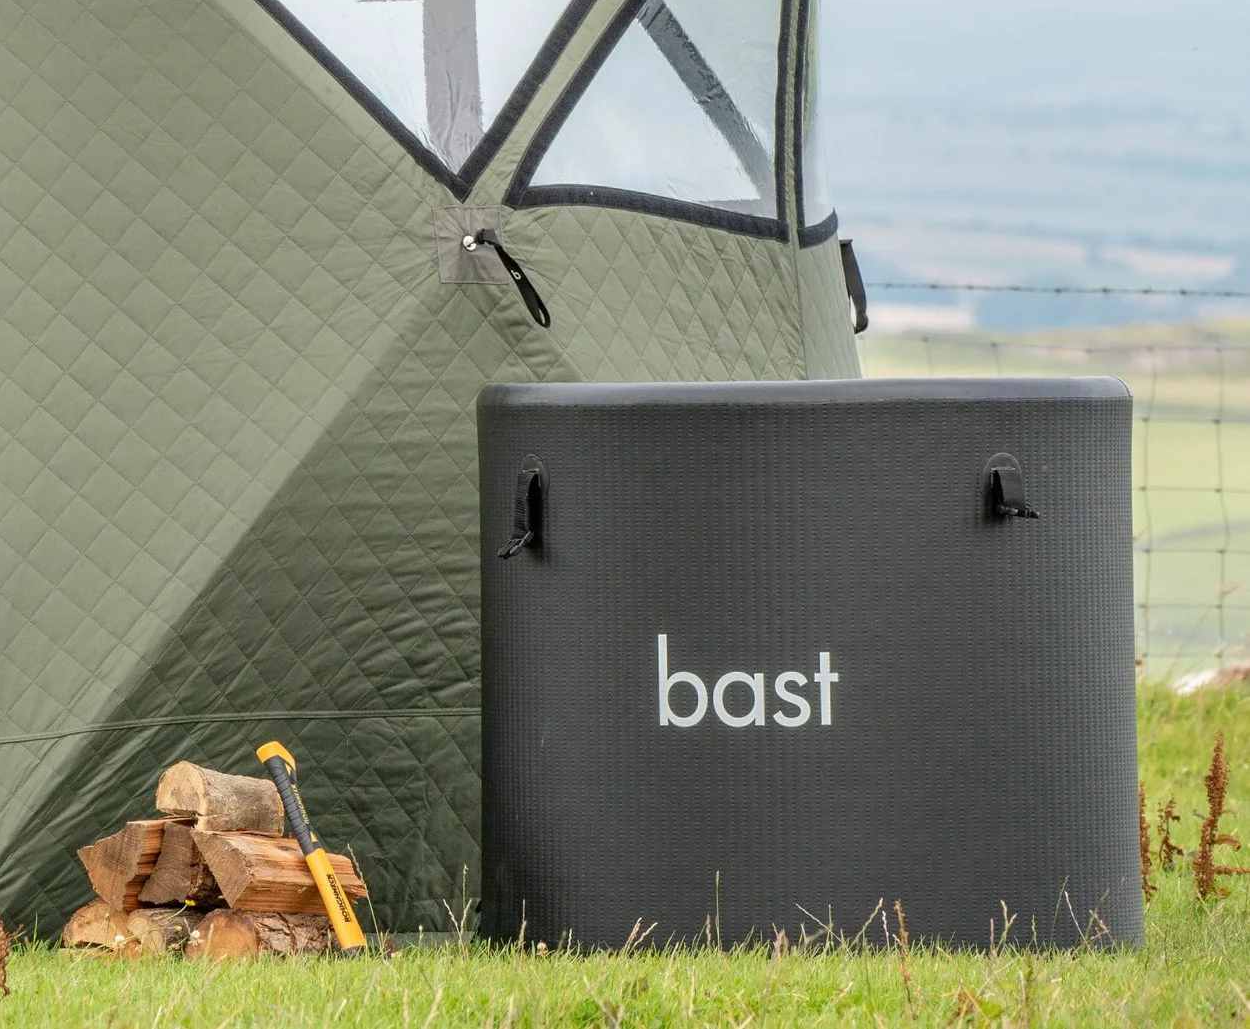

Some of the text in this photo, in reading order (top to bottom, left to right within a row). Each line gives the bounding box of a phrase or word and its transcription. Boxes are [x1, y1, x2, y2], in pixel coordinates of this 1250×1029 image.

[510, 269, 521, 280] b
[658, 634, 839, 727] bast
[326, 874, 350, 923] ROUGHNECK
